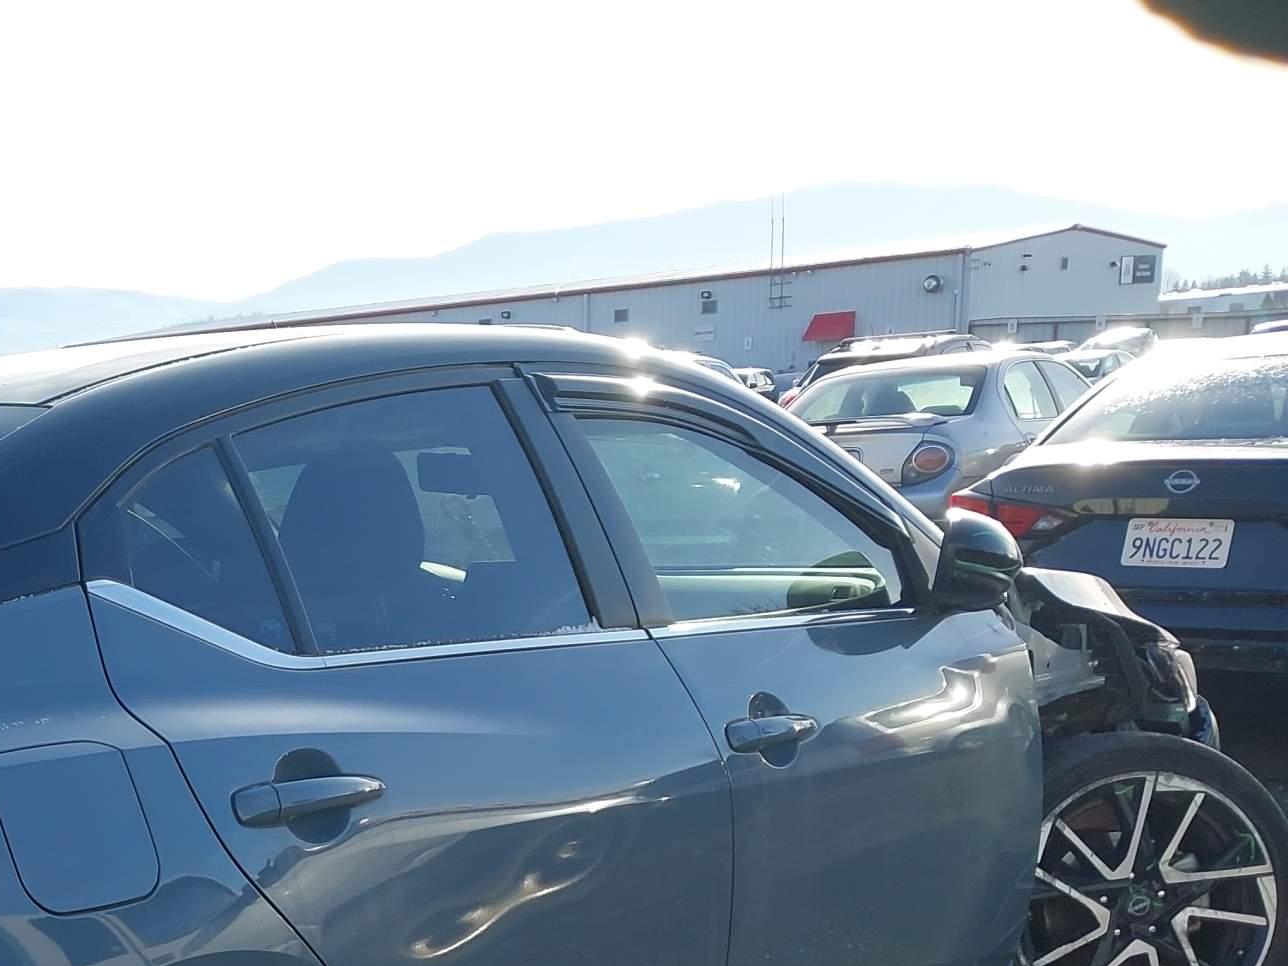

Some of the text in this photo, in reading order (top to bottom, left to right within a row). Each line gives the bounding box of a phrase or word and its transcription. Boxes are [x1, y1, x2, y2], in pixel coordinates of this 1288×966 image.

[1003, 484, 1055, 494] ALTIMA
[1149, 519, 1210, 536] California
[1129, 537, 1223, 560] 9NGC122
